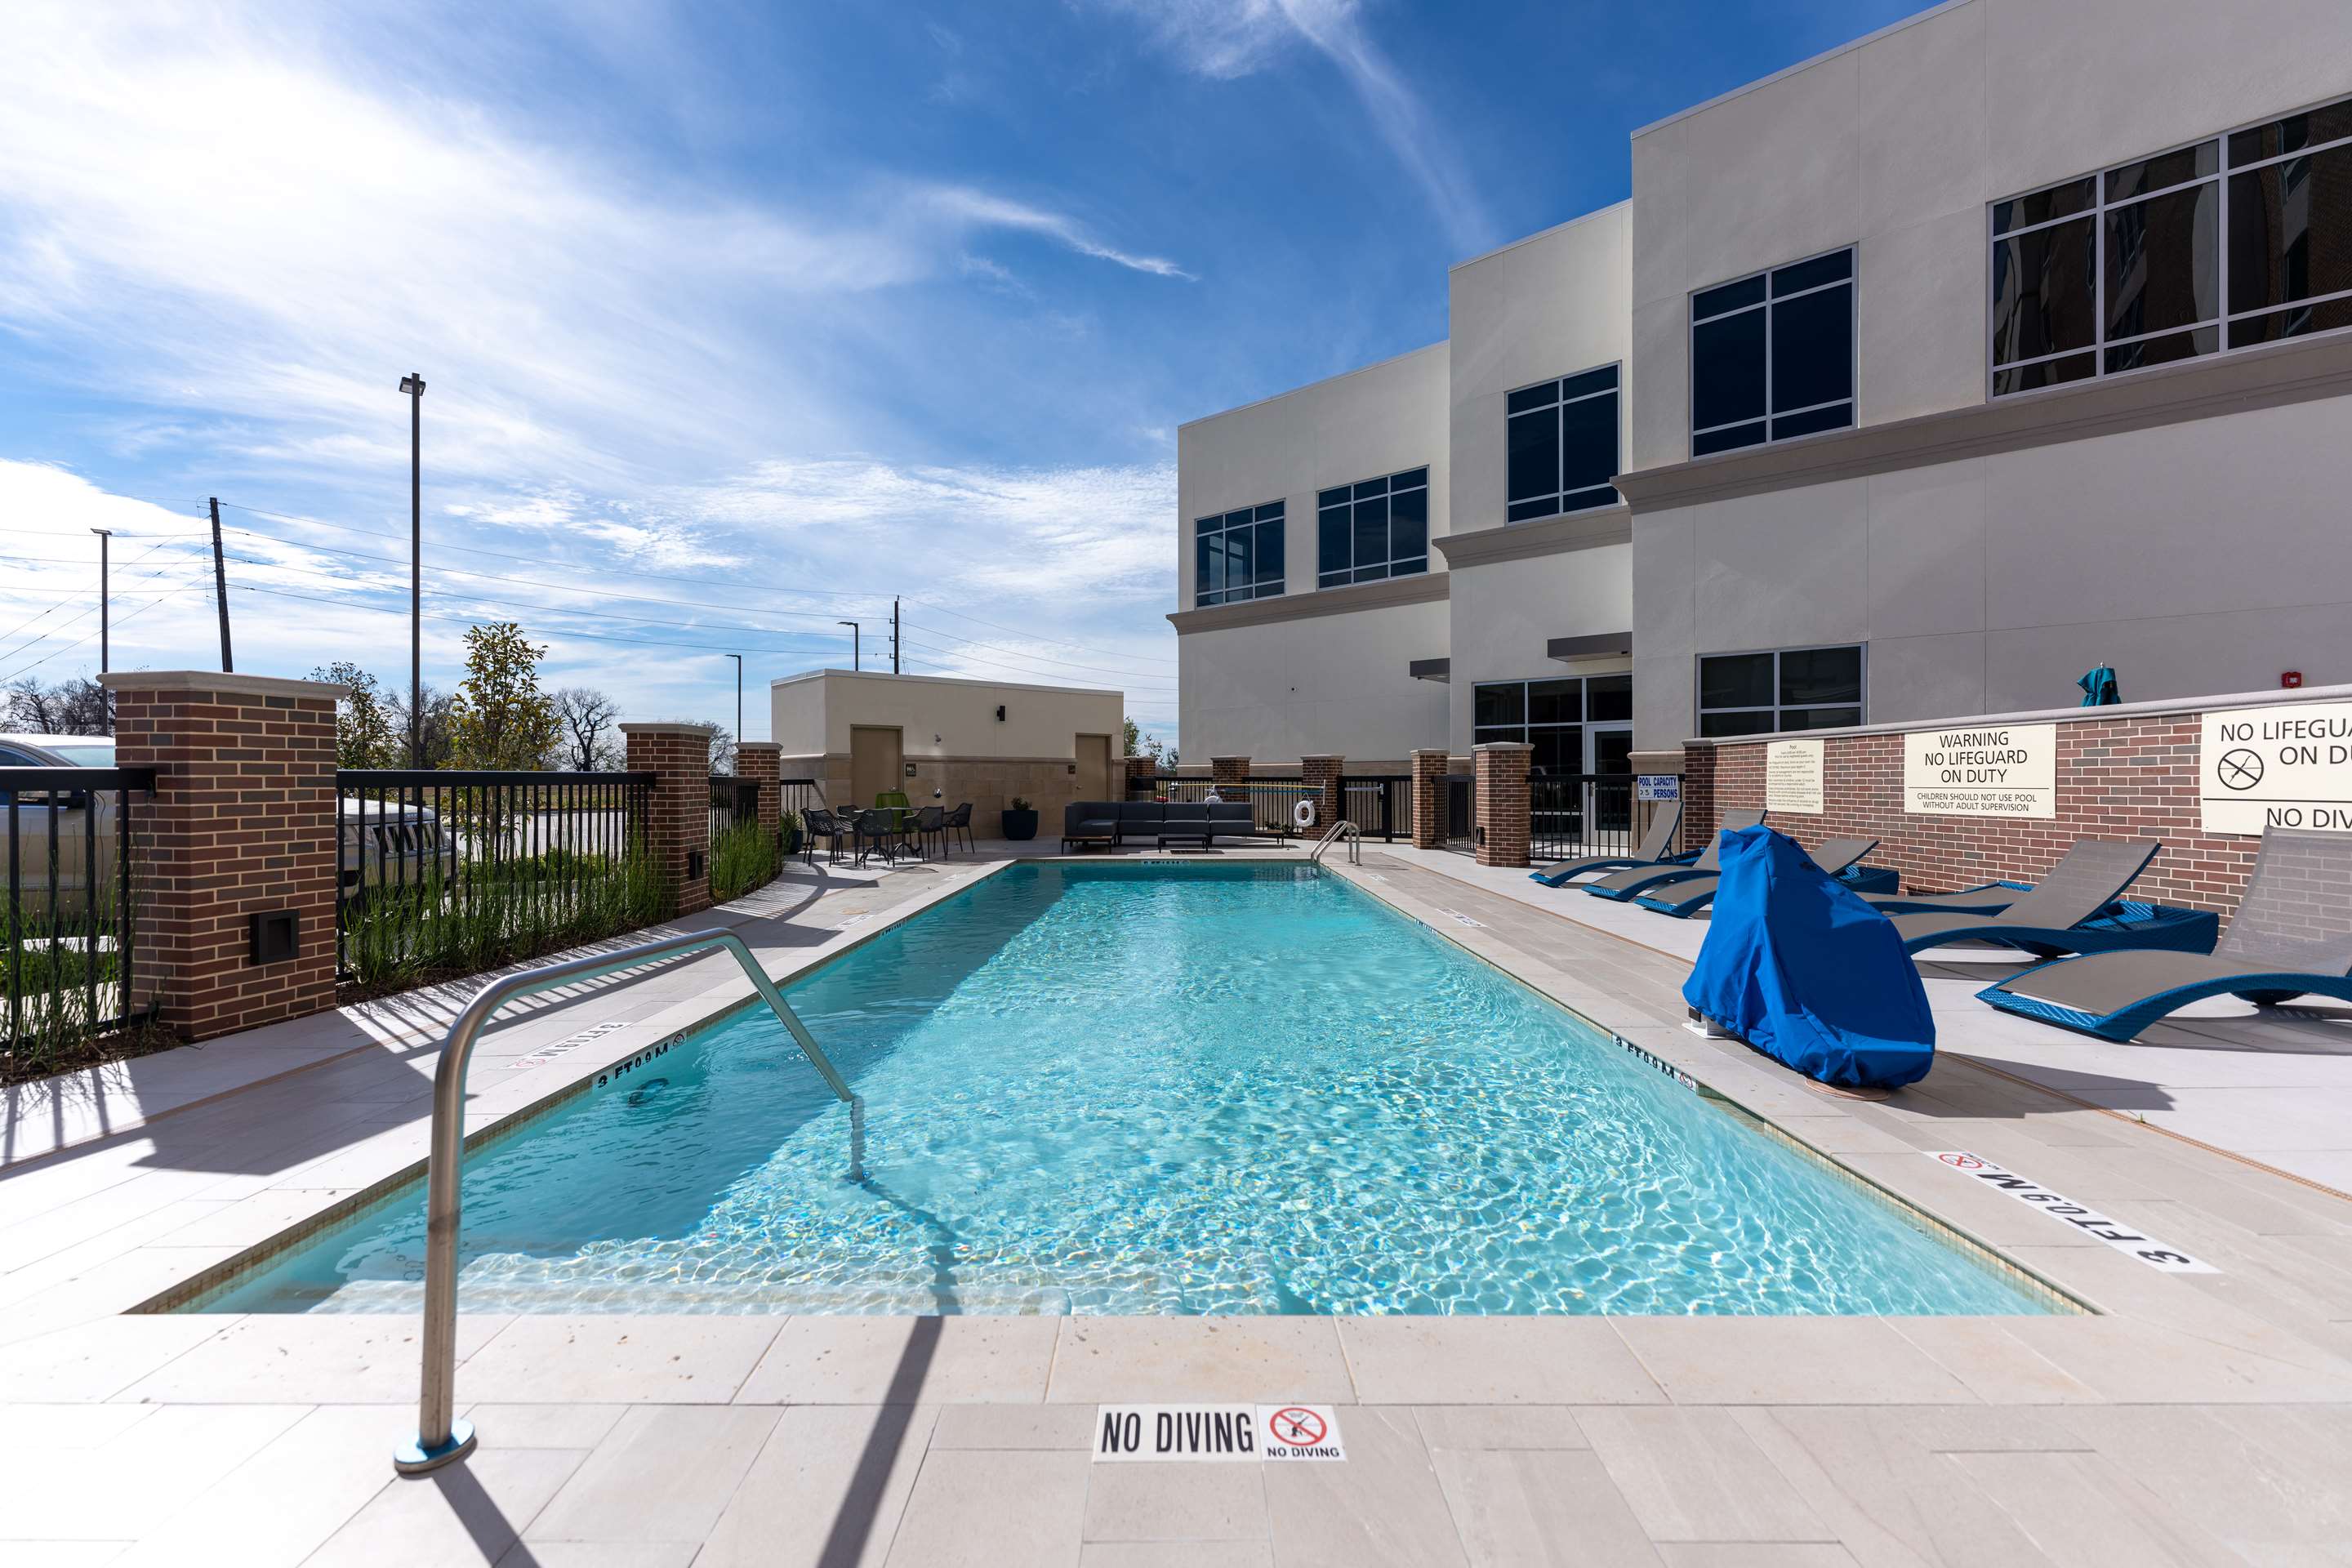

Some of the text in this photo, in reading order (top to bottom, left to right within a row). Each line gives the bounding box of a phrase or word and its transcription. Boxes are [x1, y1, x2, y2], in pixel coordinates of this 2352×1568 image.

[2221, 723, 2254, 742] NO
[1939, 732, 2009, 748] WARNING
[1925, 750, 2028, 766] NO LIFEGUARD
[2279, 745, 2352, 765] ON D
[1639, 777, 1677, 786] POOL CAPACITY
[1940, 768, 2007, 783] ON DUTY
[1654, 788, 1678, 799] PERSONS
[1917, 792, 2037, 803] CHILDREN SHOULD NOT USE POOL
[1922, 801, 2029, 812] WITHOUT ADULT SUPERVISION
[2266, 808, 2302, 827] NO
[1615, 1036, 1623, 1047] 3
[598, 1075, 608, 1089] 3
[2136, 1250, 2191, 1264] 3
[1102, 1412, 1254, 1454] NO DIVING
[1267, 1447, 1340, 1457] NO DIVING
